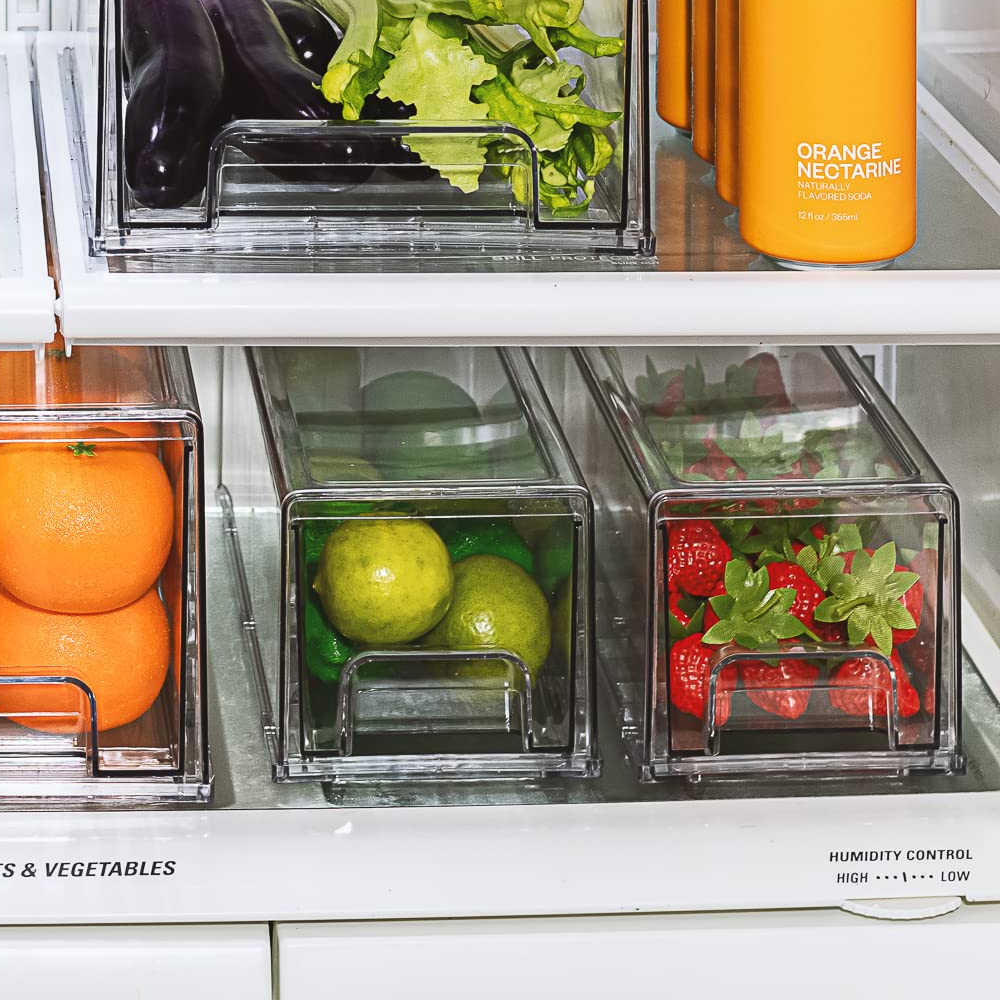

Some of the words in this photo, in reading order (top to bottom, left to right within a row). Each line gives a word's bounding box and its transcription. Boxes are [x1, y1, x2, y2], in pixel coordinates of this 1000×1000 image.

[797, 142, 882, 161] ORANGE
[797, 158, 902, 180] NECTARINE
[798, 181, 851, 191] NATURALLY
[798, 190, 847, 201] FLAVORED
[848, 192, 873, 201] SODA
[798, 210, 807, 220] 12
[808, 211, 814, 220] fl
[814, 213, 825, 221] oz
[831, 213, 858, 221] 355ml
[829, 850, 902, 862] HUMIDITY
[906, 849, 973, 861] CONTROL
[21, 862, 37, 878] &
[45, 860, 177, 878] VEGETABLES
[836, 872, 868, 884] HIGH
[940, 871, 971, 882] LOW
